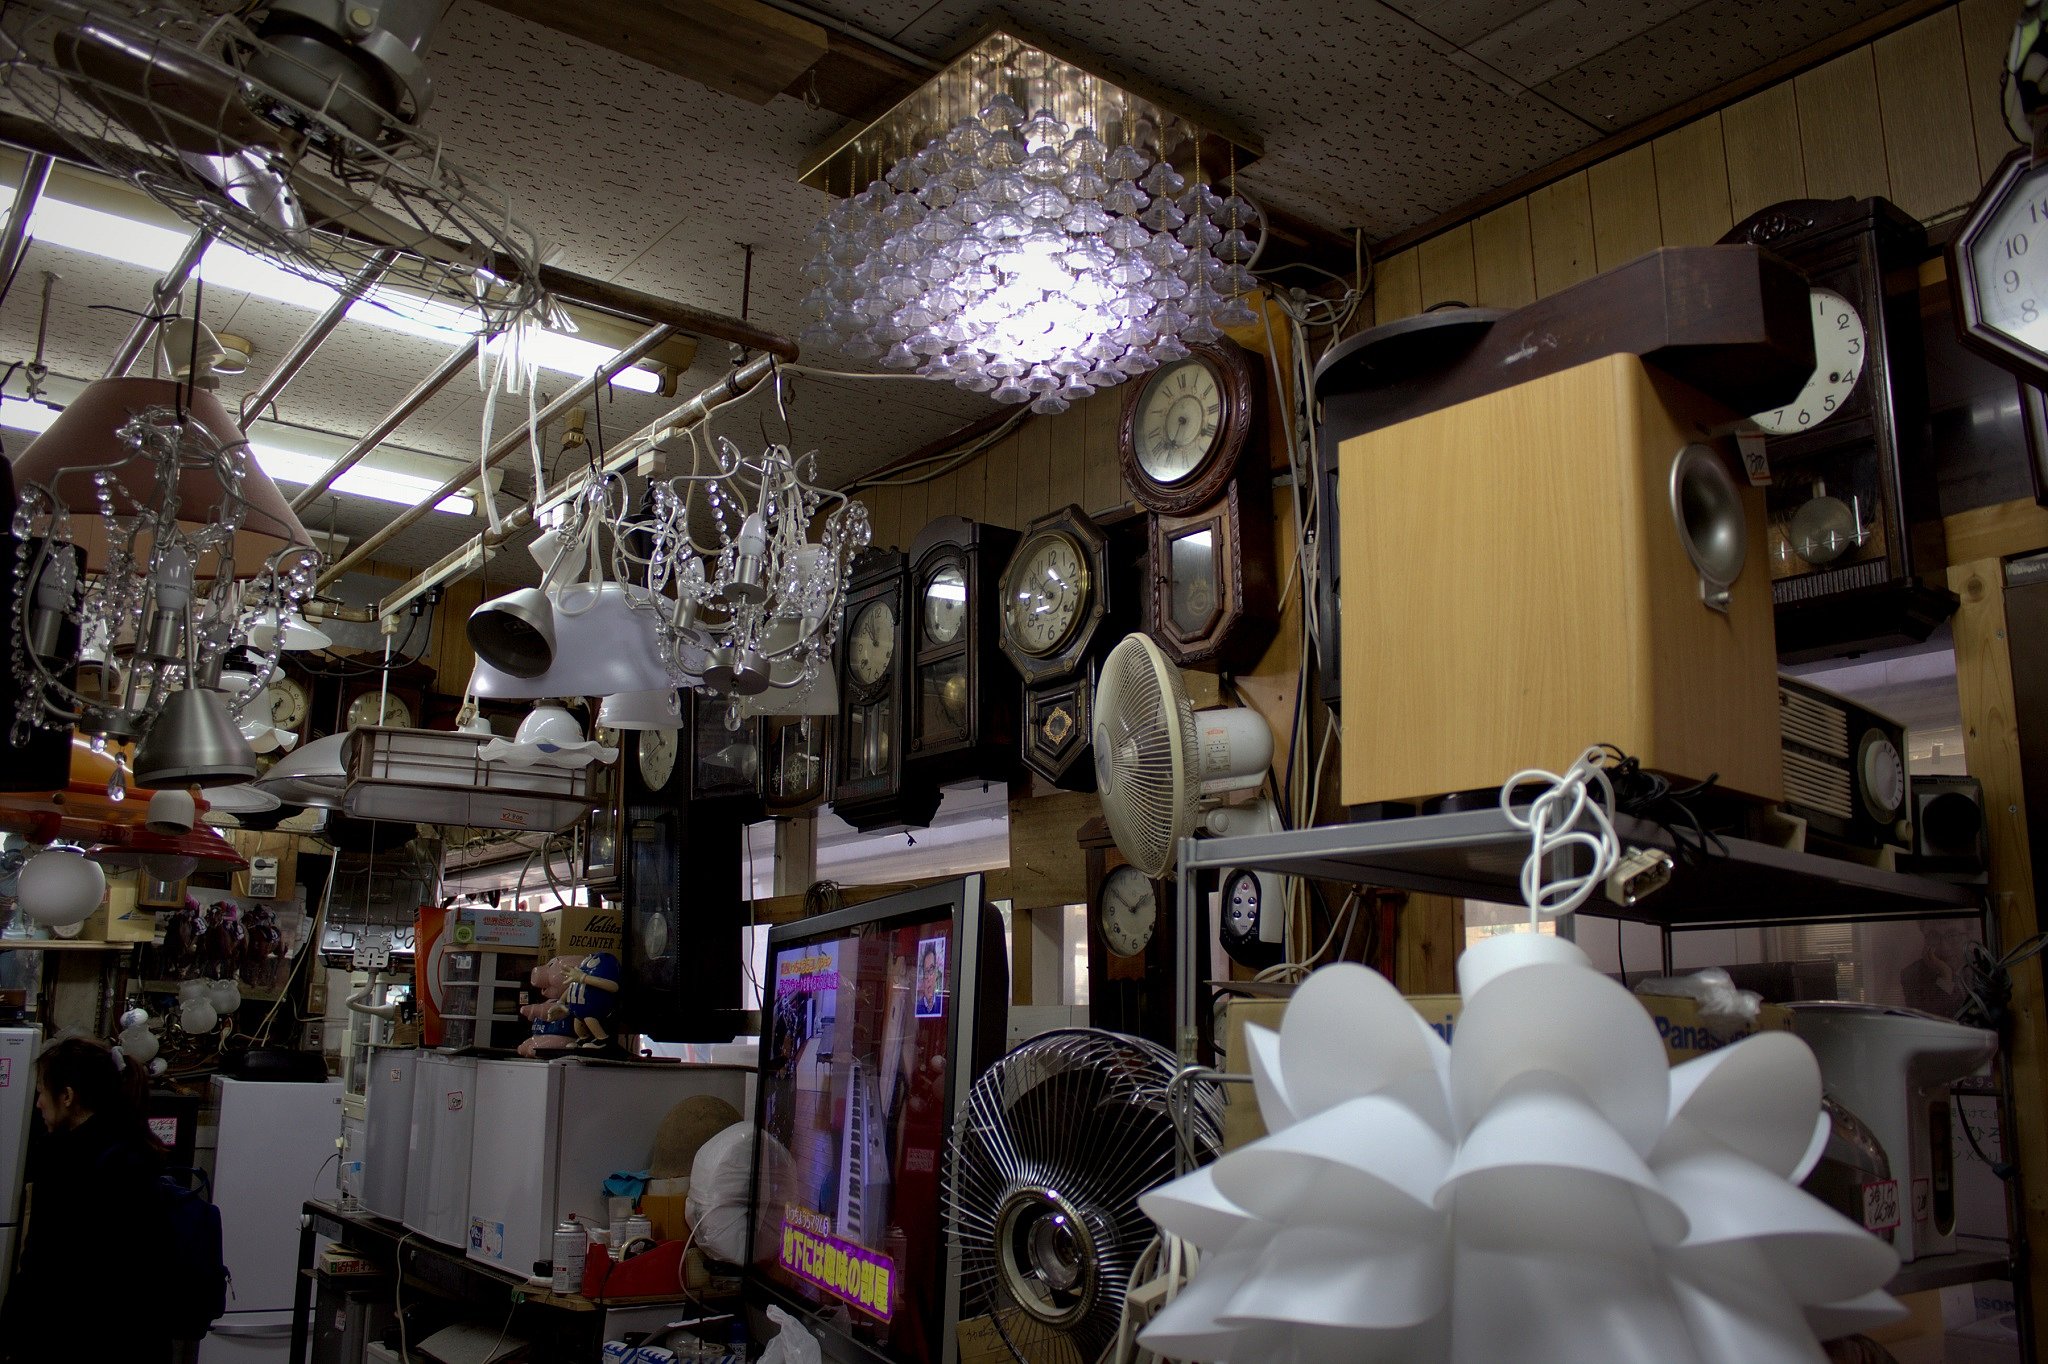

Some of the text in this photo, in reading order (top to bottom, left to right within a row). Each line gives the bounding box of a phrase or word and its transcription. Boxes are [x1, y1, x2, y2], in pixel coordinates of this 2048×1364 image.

[2005, 233, 2028, 259] 10
[2003, 270, 2020, 294] 9
[1818, 301, 1824, 316] 1
[2021, 299, 2039, 323] 8
[1836, 313, 1850, 331] 2
[1847, 337, 1860, 355] 3
[1841, 368, 1856, 385] 4
[1823, 394, 1836, 412] 5
[1773, 410, 1785, 426] 7
[1798, 408, 1811, 425] 6
[1047, 550, 1057, 567] 12
[1068, 562, 1077, 579] 2
[1072, 580, 1079, 597] 3
[1027, 613, 1035, 628] 8
[1036, 623, 1045, 640] 7
[1047, 625, 1056, 641] 6
[1109, 906, 1116, 917] 9
[583, 914, 622, 934] Kalita
[1113, 922, 1120, 934] 8
[569, 934, 615, 949] DECANTER
[1121, 934, 1127, 945] 7
[1131, 938, 1139, 950] 6
[1143, 933, 1149, 944] 5
